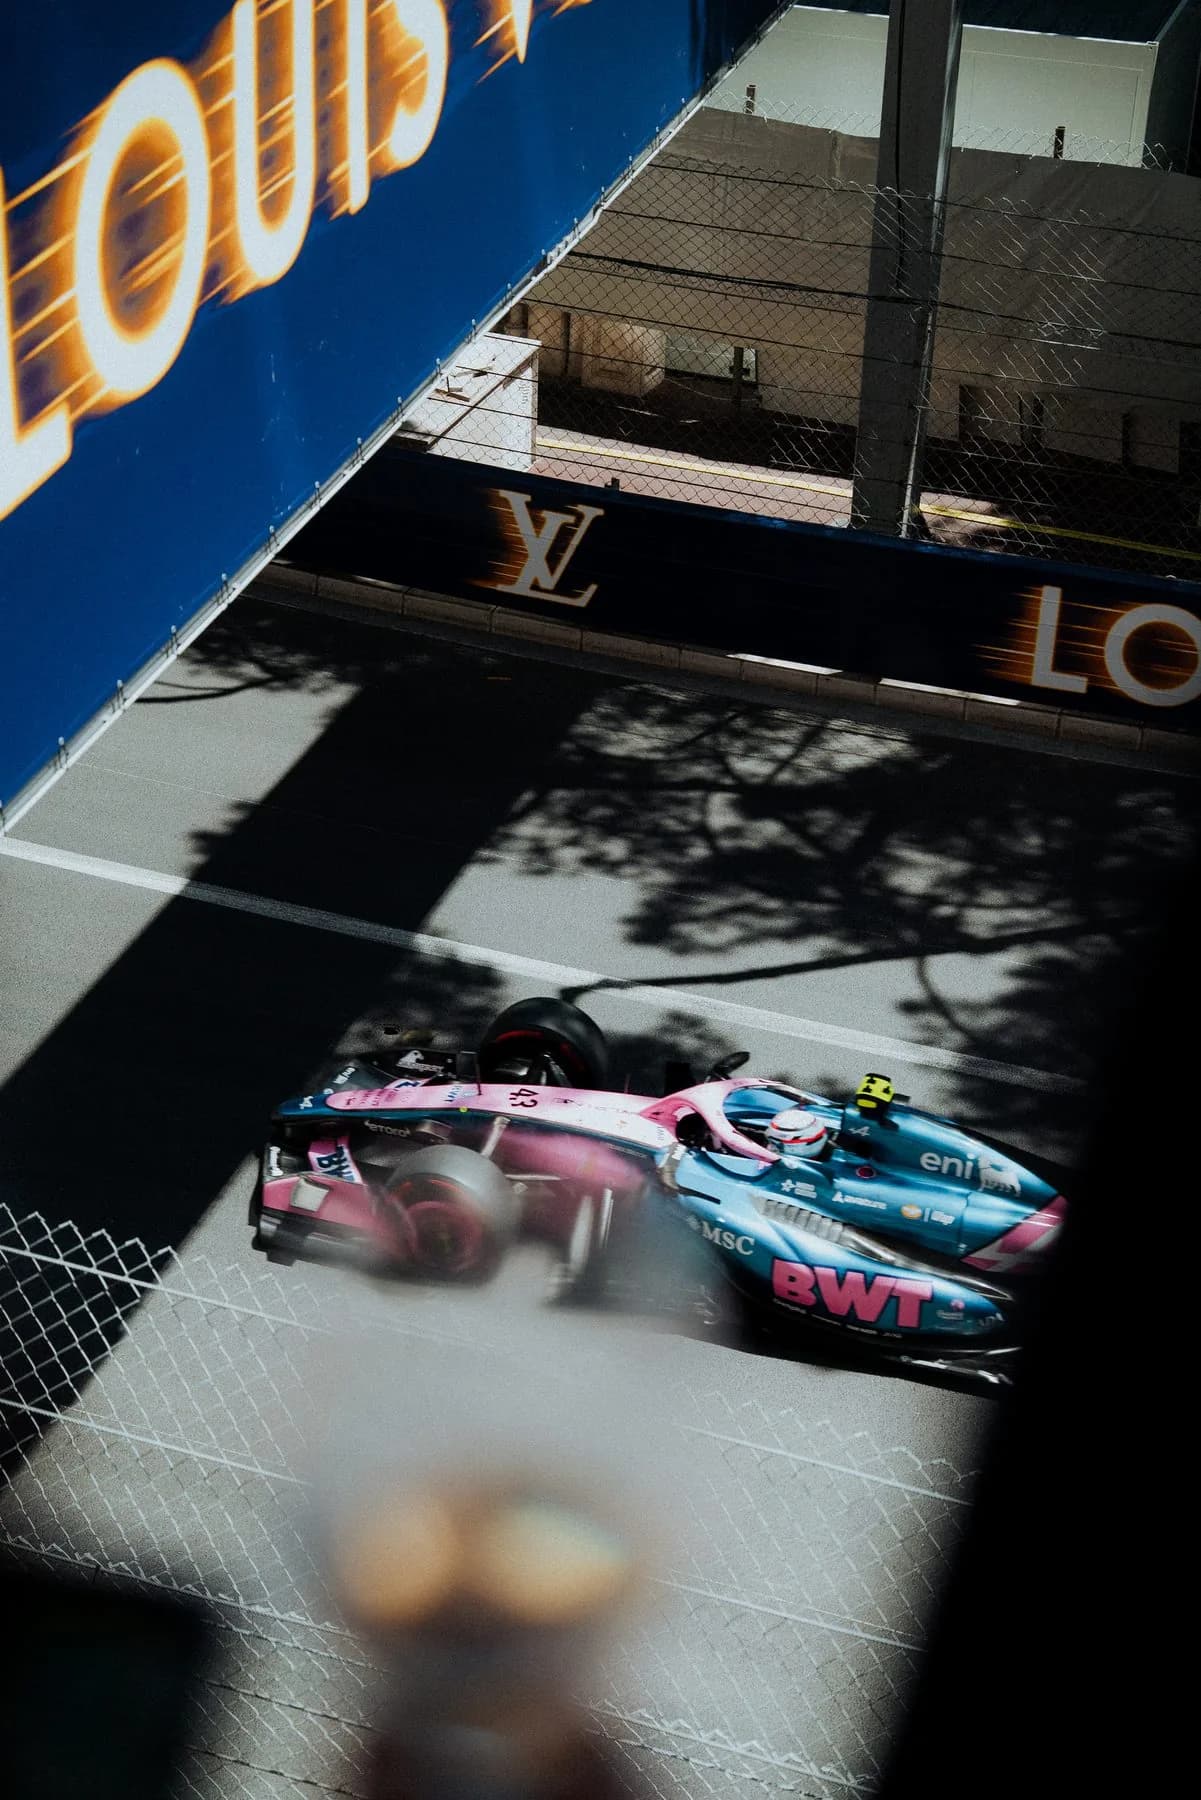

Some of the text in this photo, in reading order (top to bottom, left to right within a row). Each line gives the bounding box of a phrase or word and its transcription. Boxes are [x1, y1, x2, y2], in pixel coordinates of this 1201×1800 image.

[509, 1088, 539, 1108] 43
[920, 1153, 976, 1180] eni
[701, 1220, 756, 1256] MSC
[773, 1258, 934, 1328] BWT
